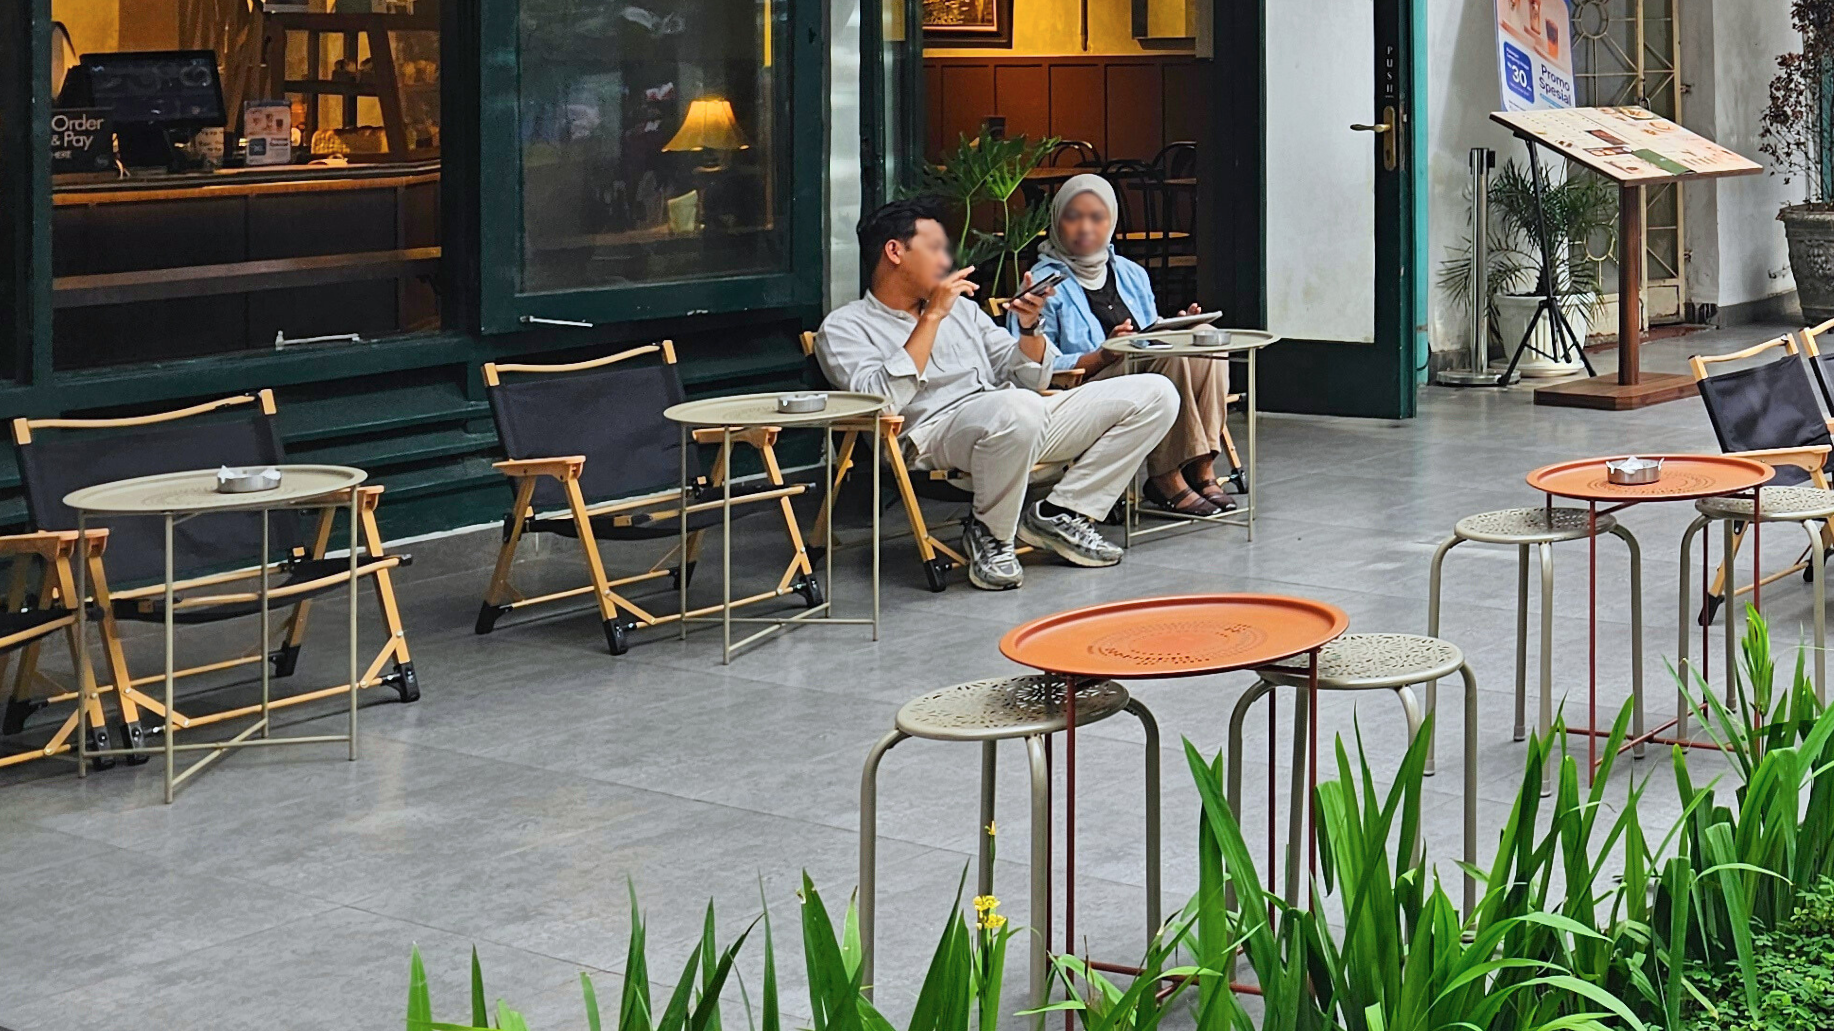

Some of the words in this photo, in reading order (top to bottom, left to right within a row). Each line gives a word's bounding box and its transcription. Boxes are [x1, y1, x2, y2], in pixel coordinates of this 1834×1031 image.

[1512, 64, 1528, 88] 30
[1541, 63, 1571, 92] Promo
[1539, 76, 1572, 107] Spesial
[51, 114, 104, 131] Order
[51, 134, 61, 144] &
[63, 131, 94, 150] Pay
